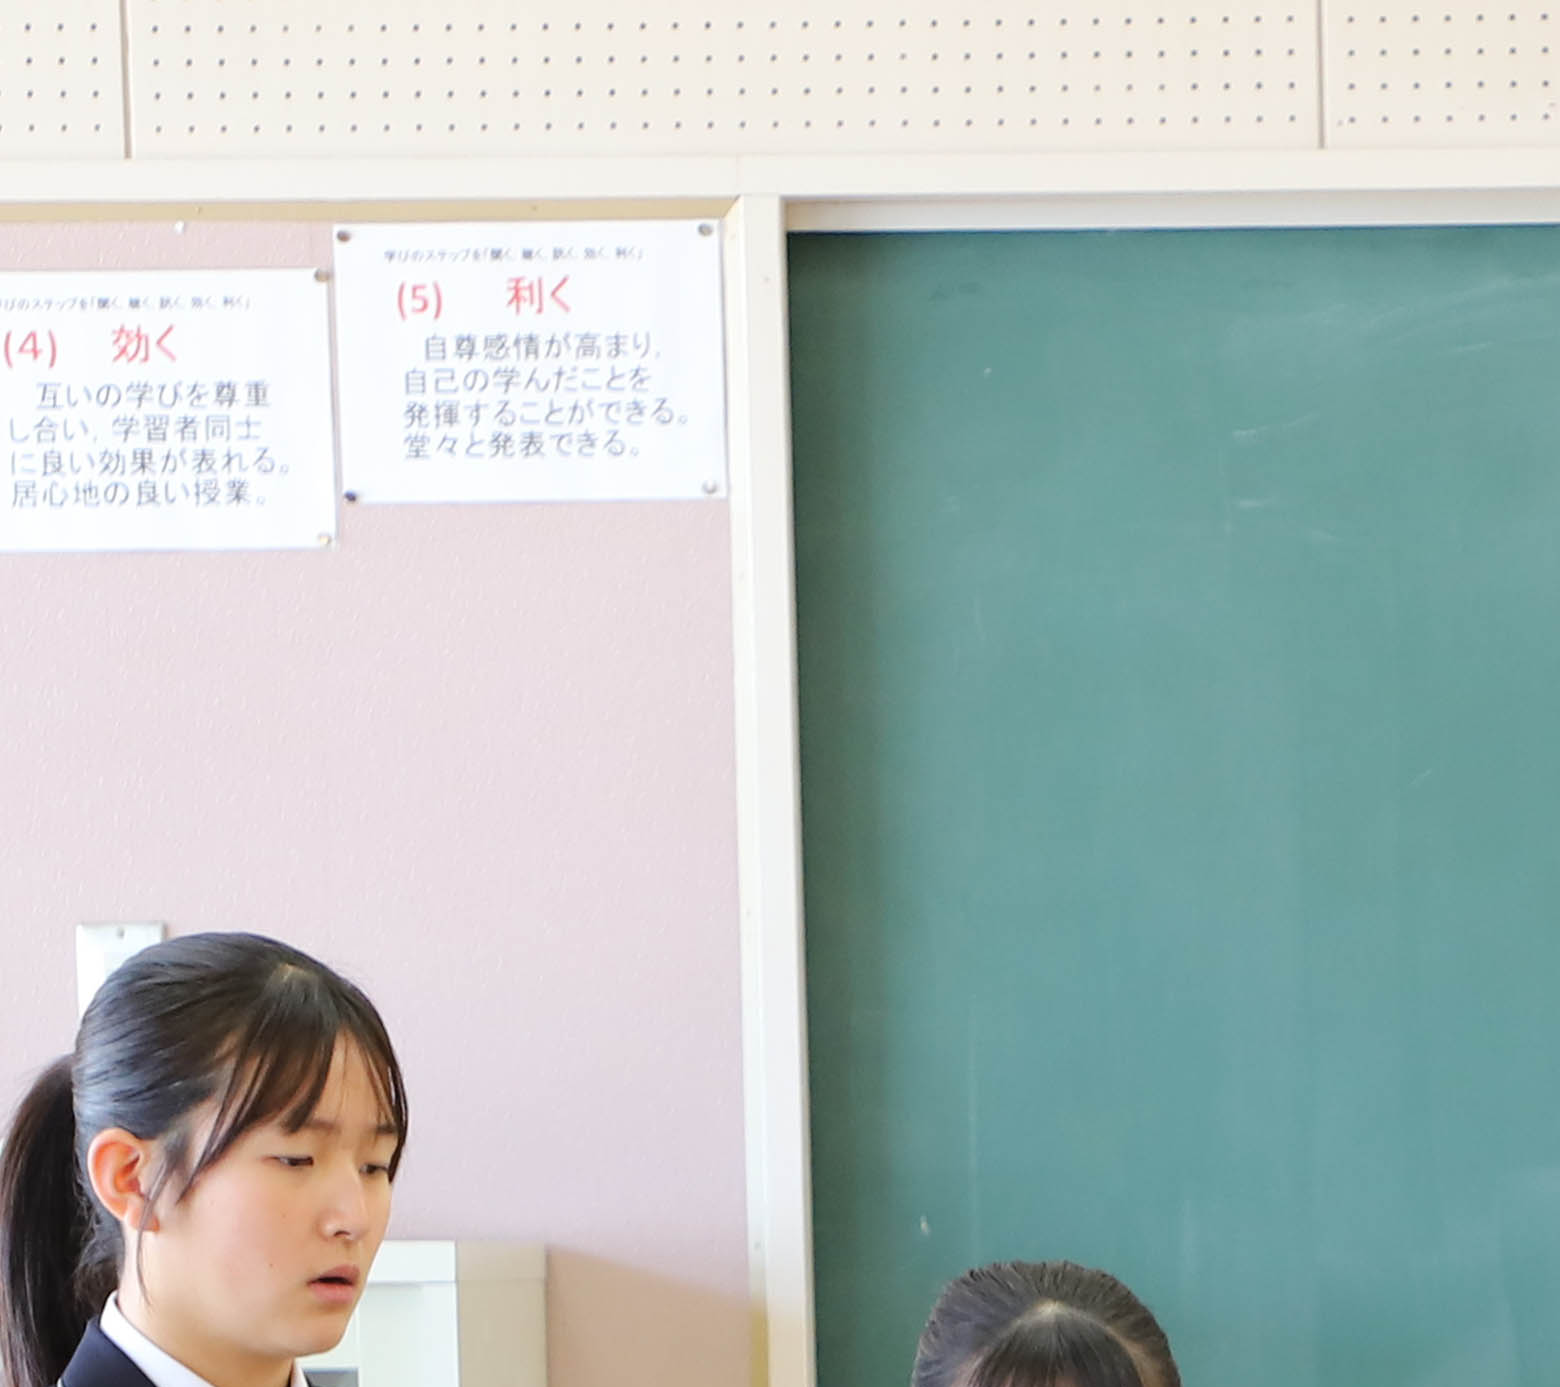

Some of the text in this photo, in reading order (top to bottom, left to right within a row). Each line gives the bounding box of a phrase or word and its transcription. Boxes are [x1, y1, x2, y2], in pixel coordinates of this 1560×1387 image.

[397, 275, 571, 321] (5) 利く
[3, 324, 177, 369] (4) 効く
[37, 380, 271, 410] 互いの学びを尊重
[404, 365, 652, 395] 自己の学んだことを
[404, 398, 689, 430] 発揮することができる。
[404, 429, 641, 460] 堂々と発表できる。
[11, 447, 291, 477] に良い効果が表れる。
[12, 480, 267, 510] 居心地の良い授業。
